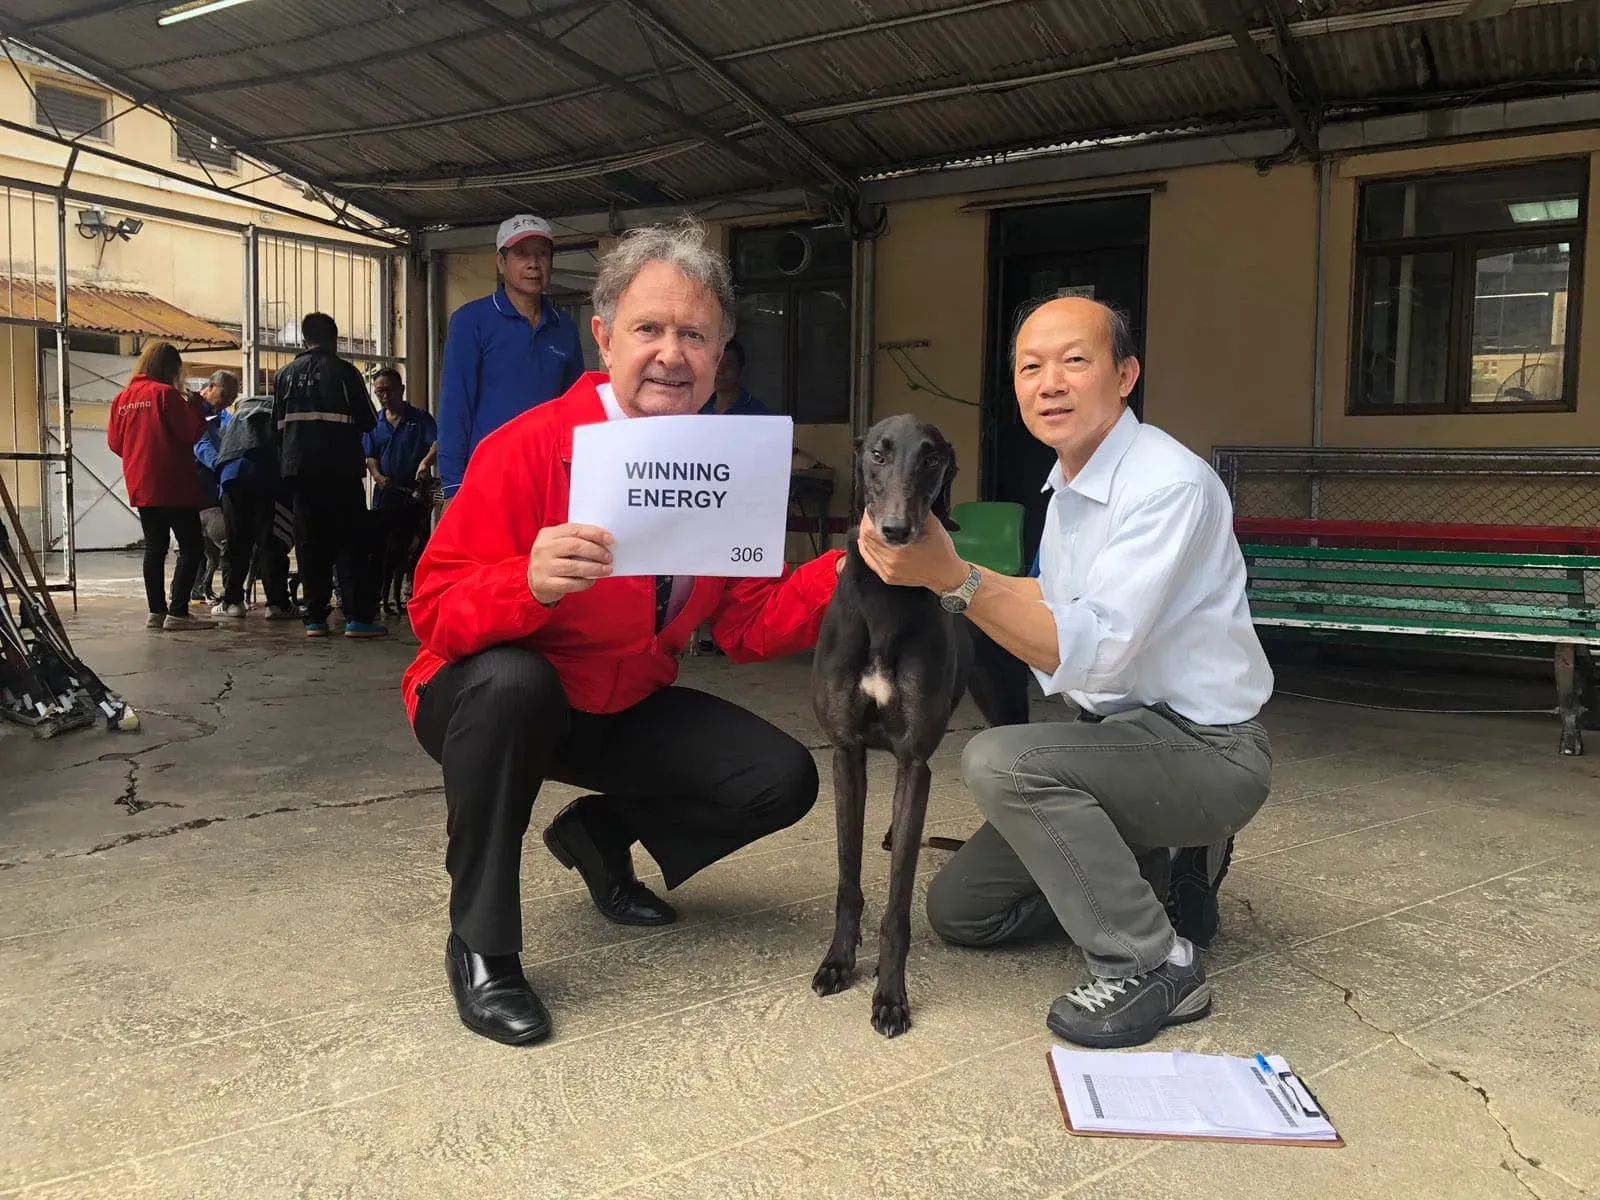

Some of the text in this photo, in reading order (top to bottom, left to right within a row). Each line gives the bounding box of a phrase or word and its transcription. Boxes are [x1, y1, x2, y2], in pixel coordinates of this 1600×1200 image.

[625, 462, 730, 482] WINNING
[628, 488, 728, 509] ENERGY
[730, 547, 764, 563] 306
